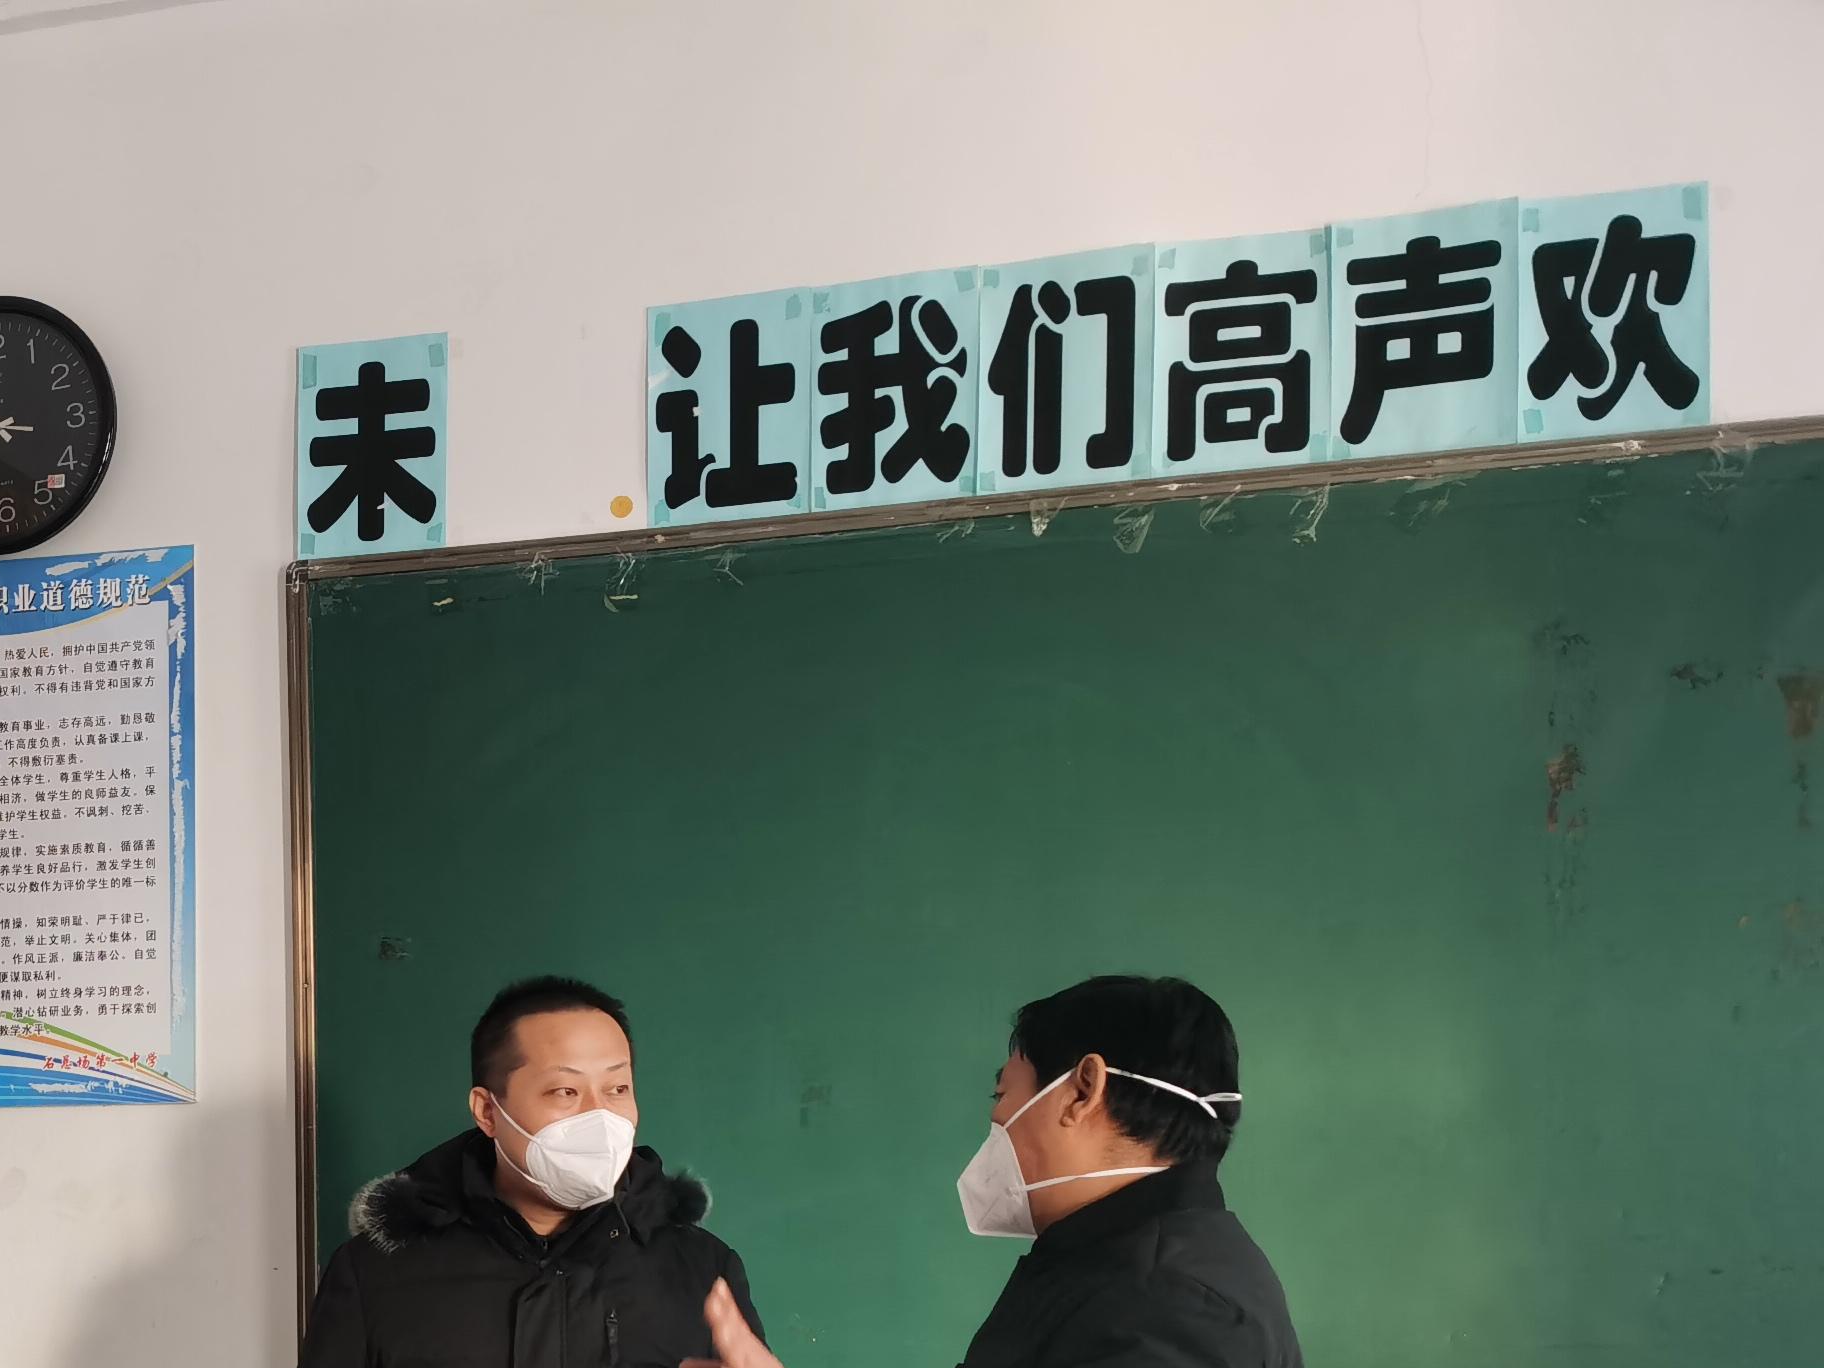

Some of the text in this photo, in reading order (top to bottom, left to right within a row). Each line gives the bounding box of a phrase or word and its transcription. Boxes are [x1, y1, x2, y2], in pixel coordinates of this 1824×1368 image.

[26, 338, 35, 364] 1
[656, 215, 1701, 511] 让我们高声欢
[50, 363, 71, 391] 2
[66, 402, 86, 428] 3
[56, 445, 78, 470] 4
[307, 361, 437, 542] 未
[34, 478, 53, 505] 5
